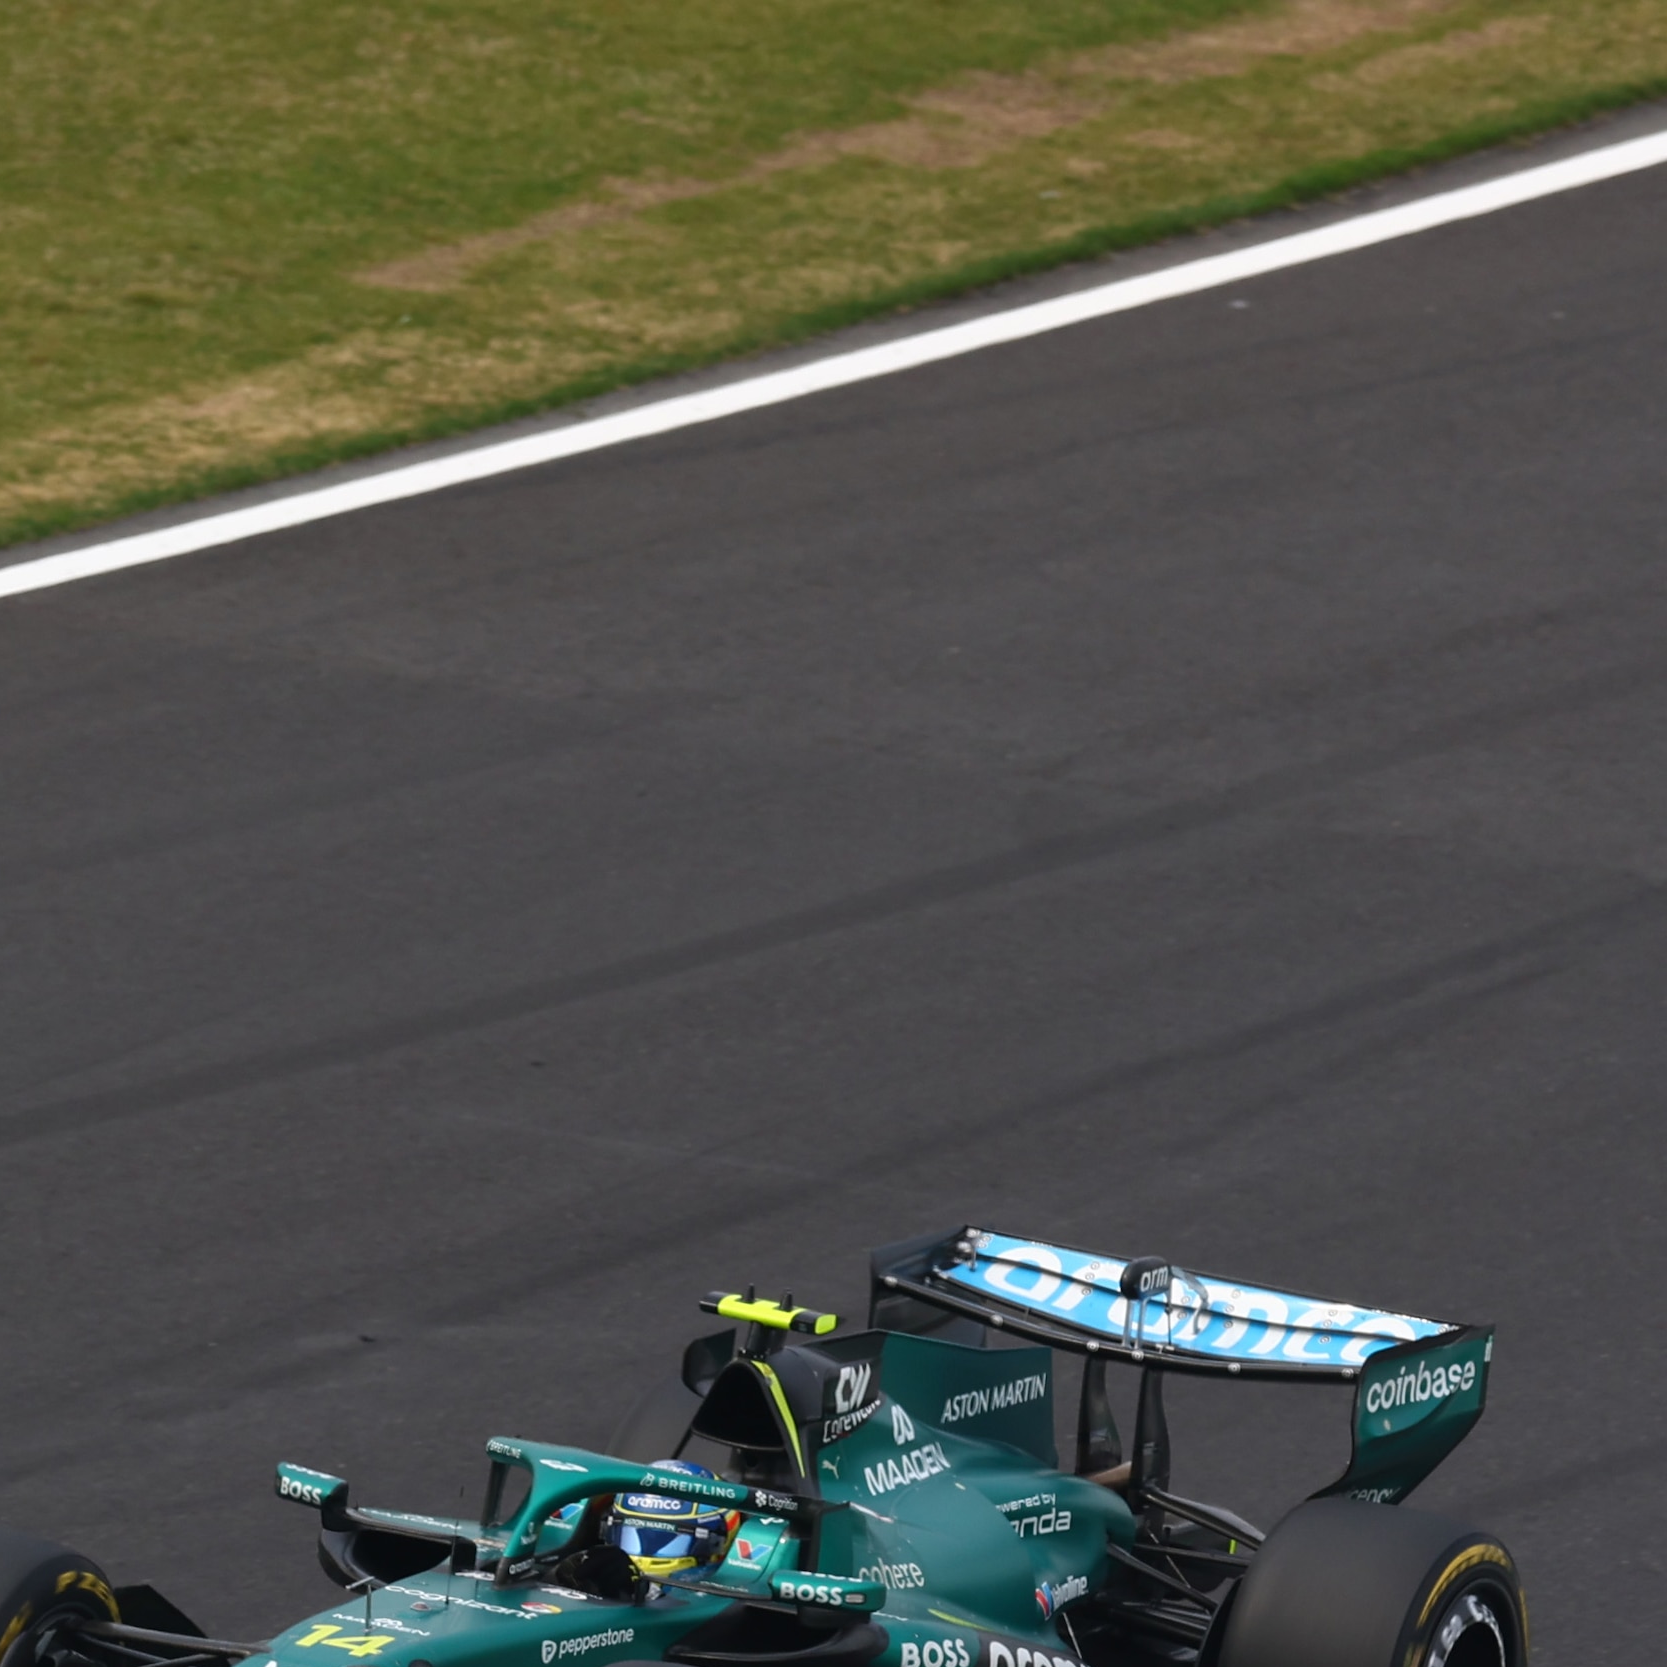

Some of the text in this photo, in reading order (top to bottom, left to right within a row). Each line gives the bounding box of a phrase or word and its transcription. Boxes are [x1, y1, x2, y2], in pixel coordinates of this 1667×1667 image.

[1140, 1265, 1168, 1293] arm
[940, 1373, 1047, 1424] ASTON MARTIN
[1366, 1360, 1476, 1414] coinbase
[863, 1441, 951, 1496] MAADEN
[279, 1475, 323, 1505] BOSS
[627, 1493, 682, 1511] aramco
[658, 1477, 736, 1500] BREITLING
[768, 1495, 799, 1511] Cognition
[384, 1585, 539, 1620] cognizant
[780, 1581, 844, 1606] BOSS
[295, 1624, 396, 1658] 14
[558, 1628, 635, 1659] pepperstone
